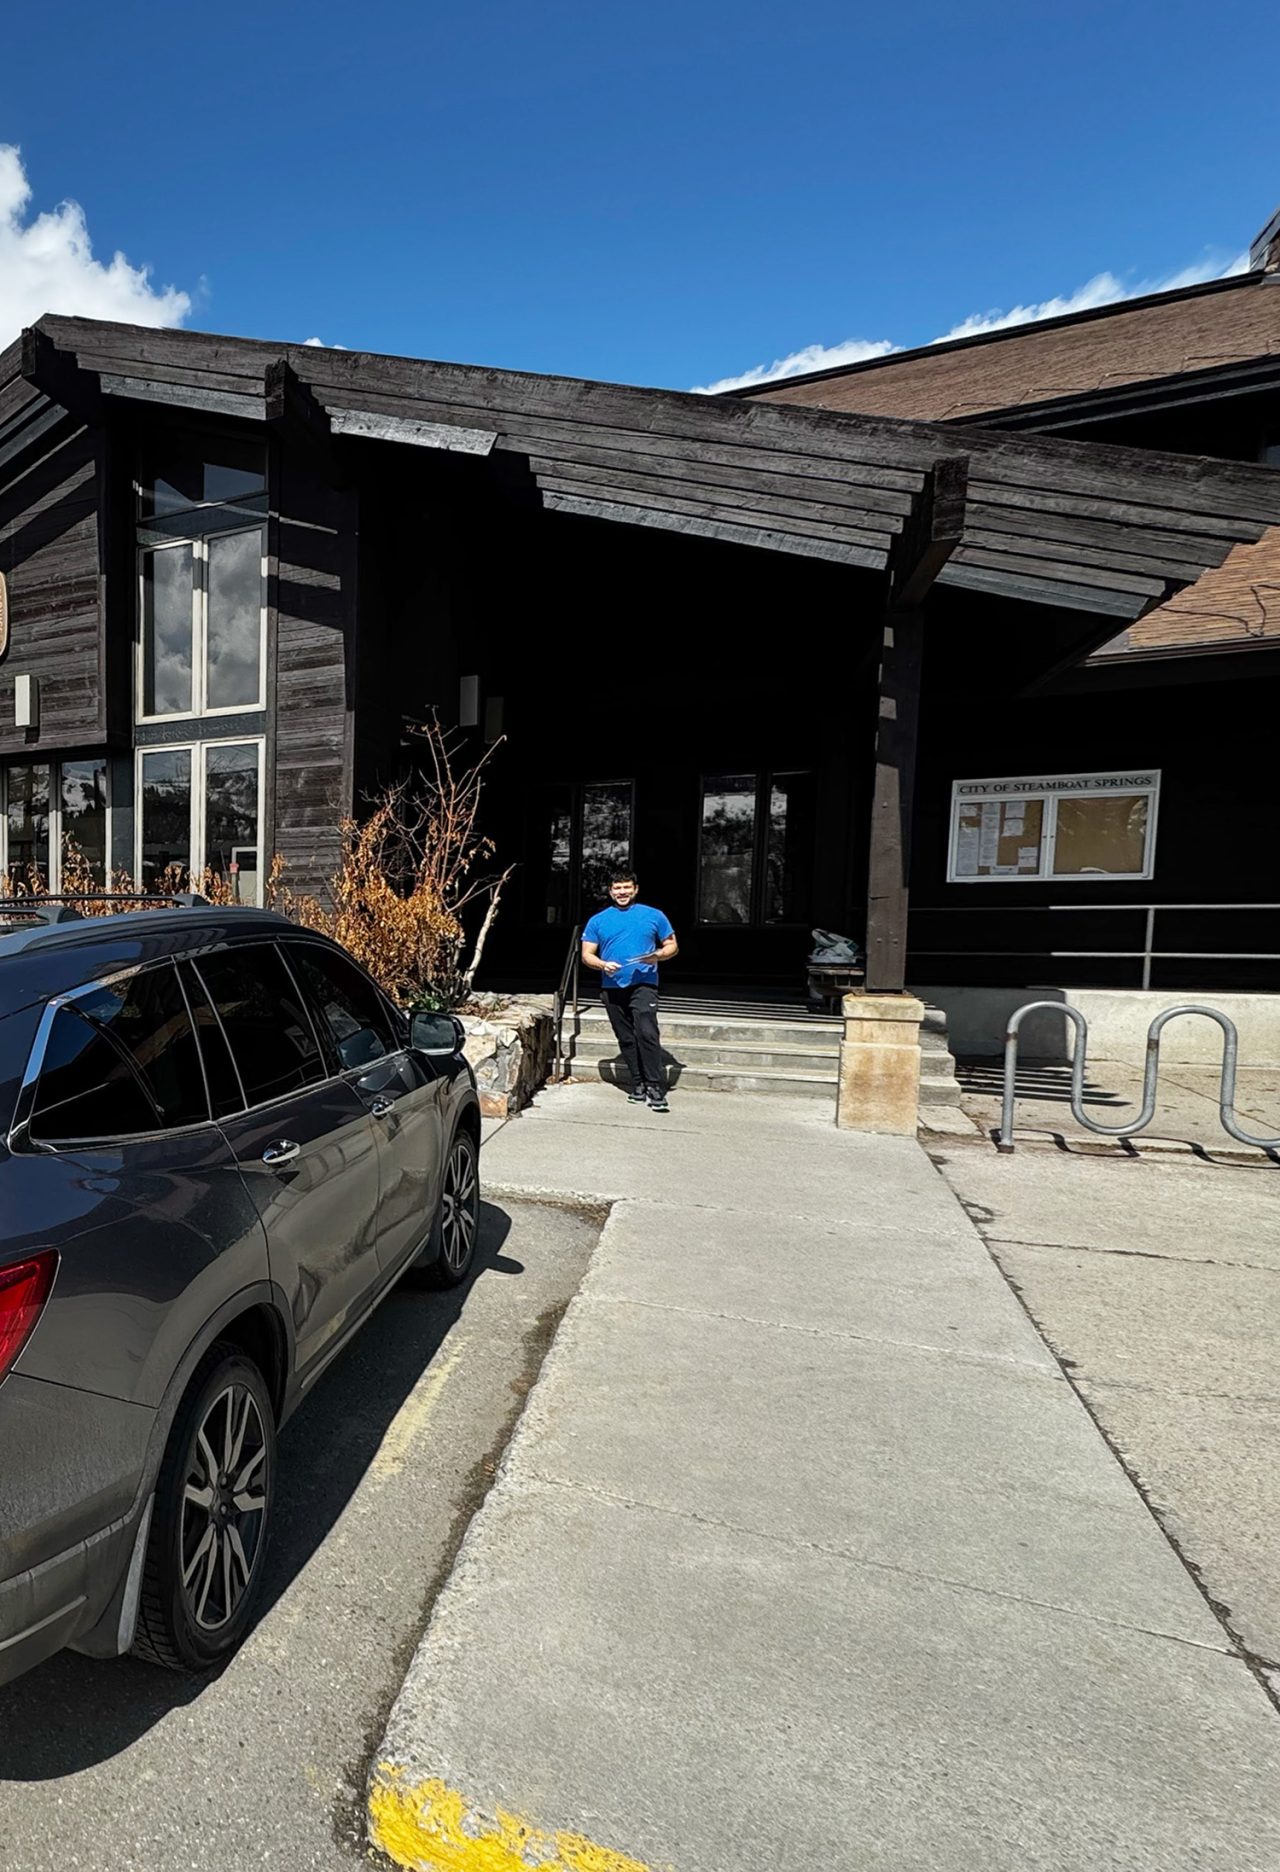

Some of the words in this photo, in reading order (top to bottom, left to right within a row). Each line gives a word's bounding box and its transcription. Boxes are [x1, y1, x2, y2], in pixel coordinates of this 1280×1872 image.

[959, 785, 989, 794] CITY
[993, 784, 1009, 792] OF
[1013, 779, 1091, 791] STEAMBOAT
[1094, 776, 1152, 787] SPRINGS
